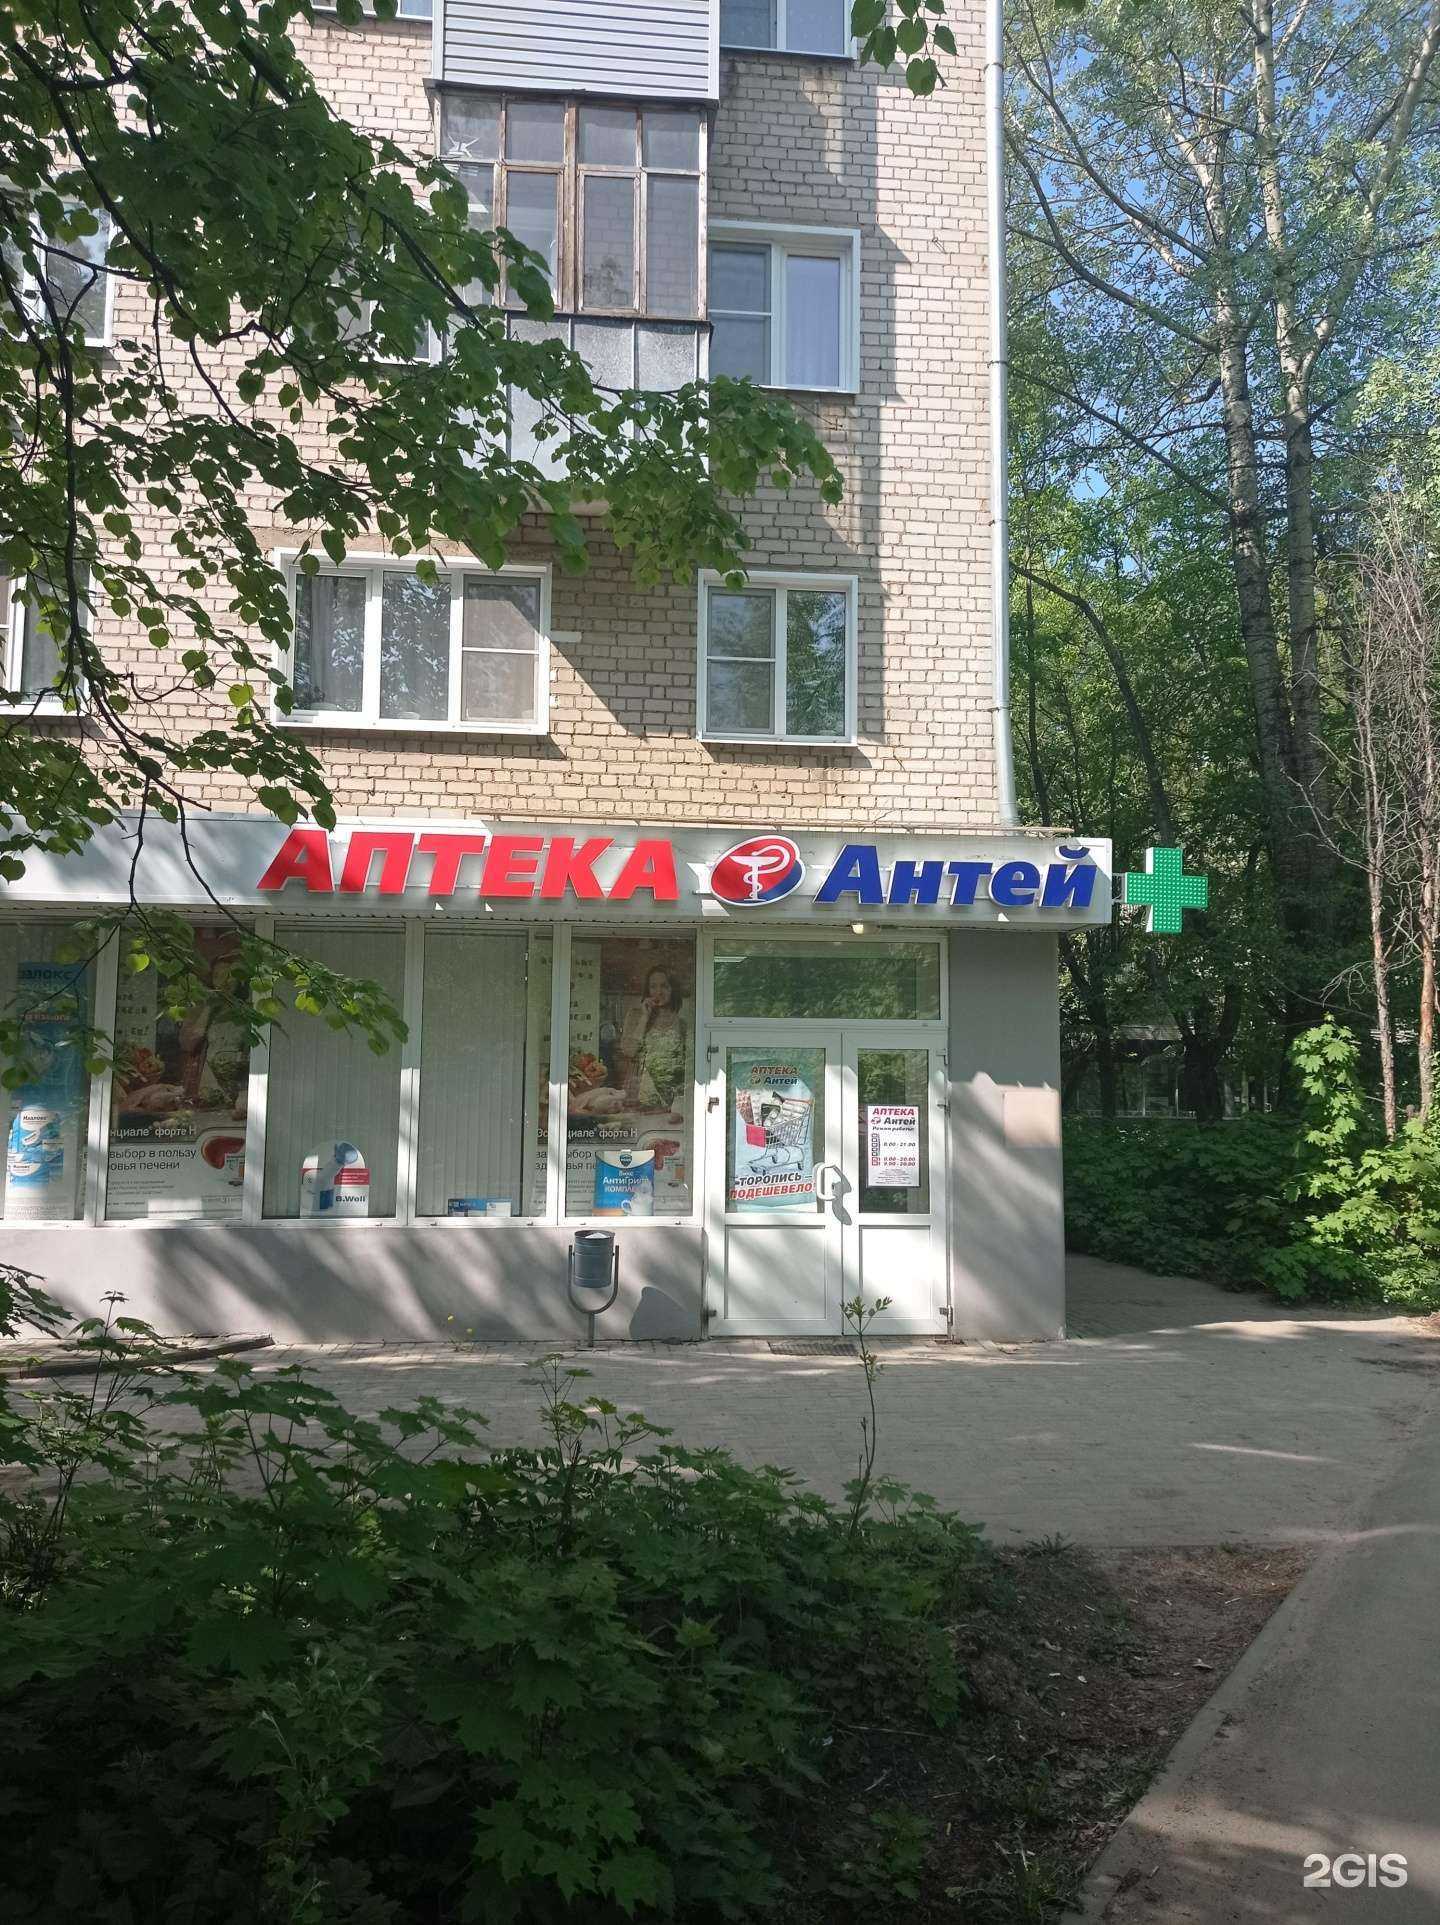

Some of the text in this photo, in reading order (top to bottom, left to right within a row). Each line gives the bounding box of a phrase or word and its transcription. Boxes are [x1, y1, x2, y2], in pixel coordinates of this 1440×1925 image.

[256, 829, 1097, 908] АПТЕКА Антей
[751, 1065, 798, 1075] АПТЕКА
[764, 1076, 798, 1085] Антей
[872, 1107, 915, 1116] АПТЕКА
[884, 1117, 916, 1126] Антей
[154, 1126, 186, 1139] форте
[598, 1127, 629, 1140] форте
[157, 1149, 197, 1159] пользу
[138, 1161, 180, 1170] печени
[740, 1172, 802, 1186] ТОРОПИСЬ
